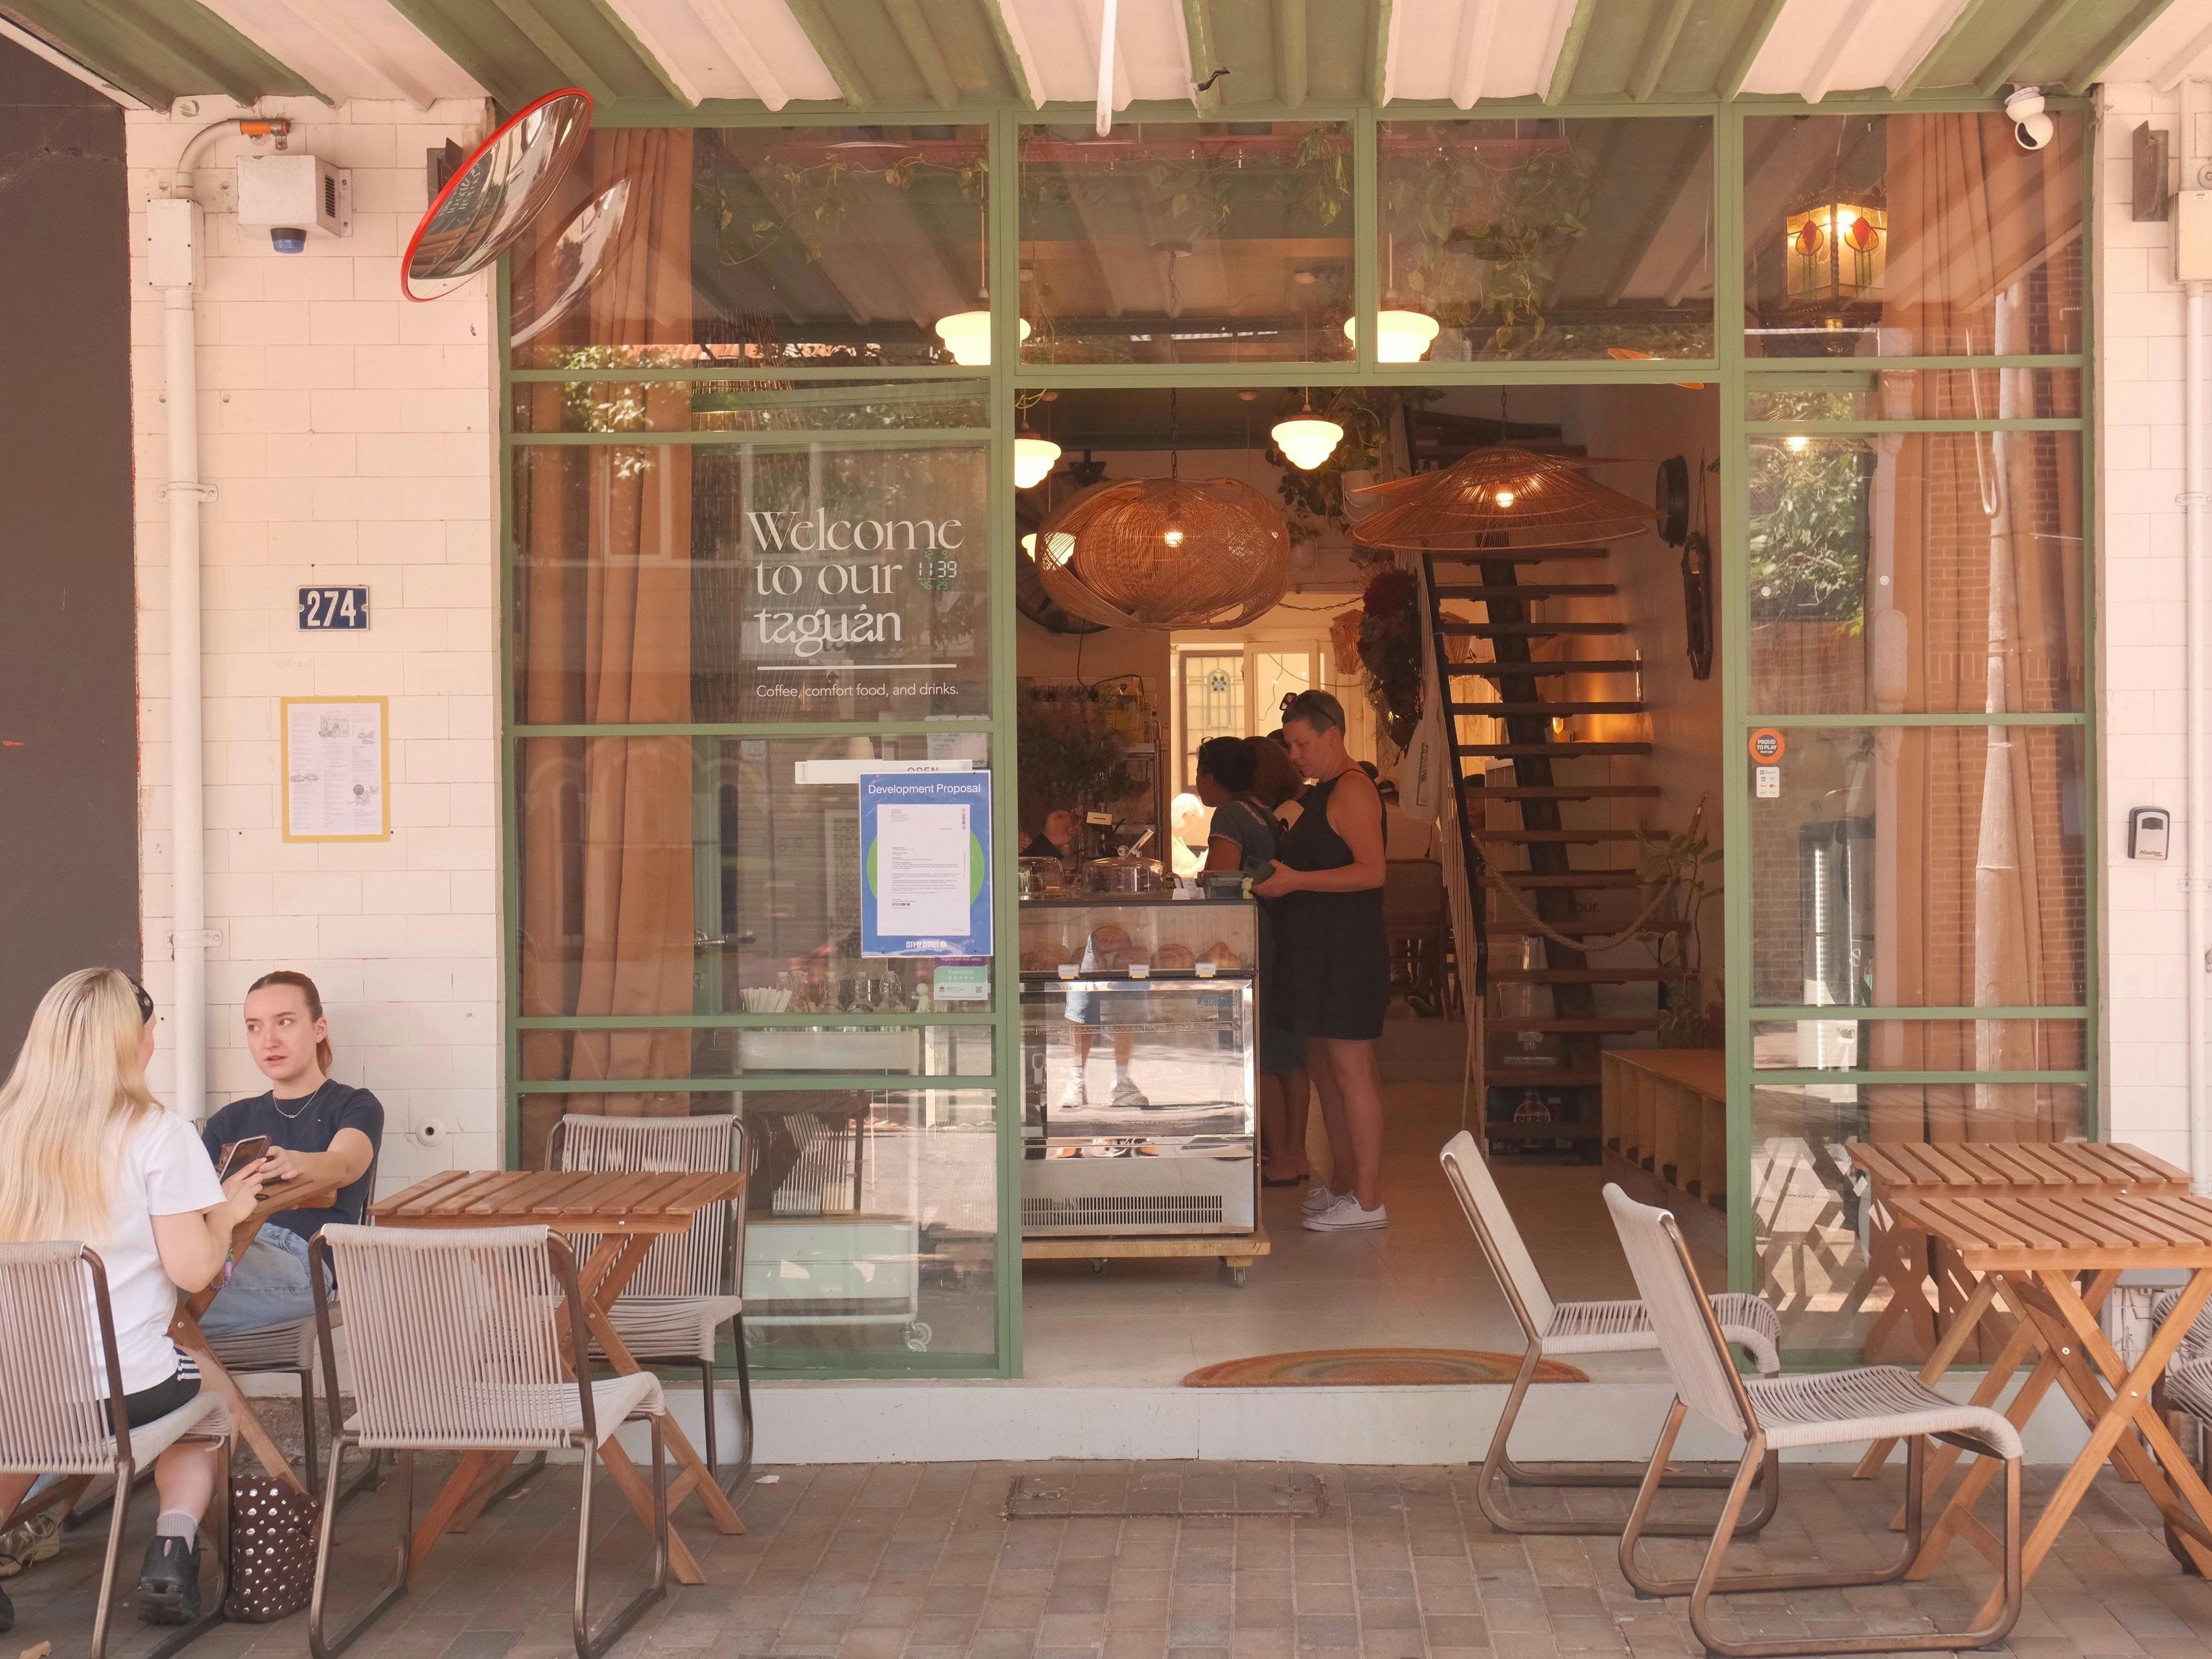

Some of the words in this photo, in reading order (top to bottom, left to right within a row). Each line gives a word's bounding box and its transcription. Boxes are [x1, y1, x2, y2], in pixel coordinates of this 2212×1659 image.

[745, 507, 964, 551] Welcome
[754, 560, 802, 595] to
[818, 563, 902, 594] our
[308, 590, 356, 626] 274
[754, 603, 901, 657] taguán
[756, 684, 801, 698] Coffee,
[805, 683, 854, 696] comfort
[856, 683, 889, 697] food,
[892, 683, 915, 695] and
[919, 682, 959, 695] drinks.
[868, 784, 935, 796] Development
[937, 783, 981, 795] Proposal
